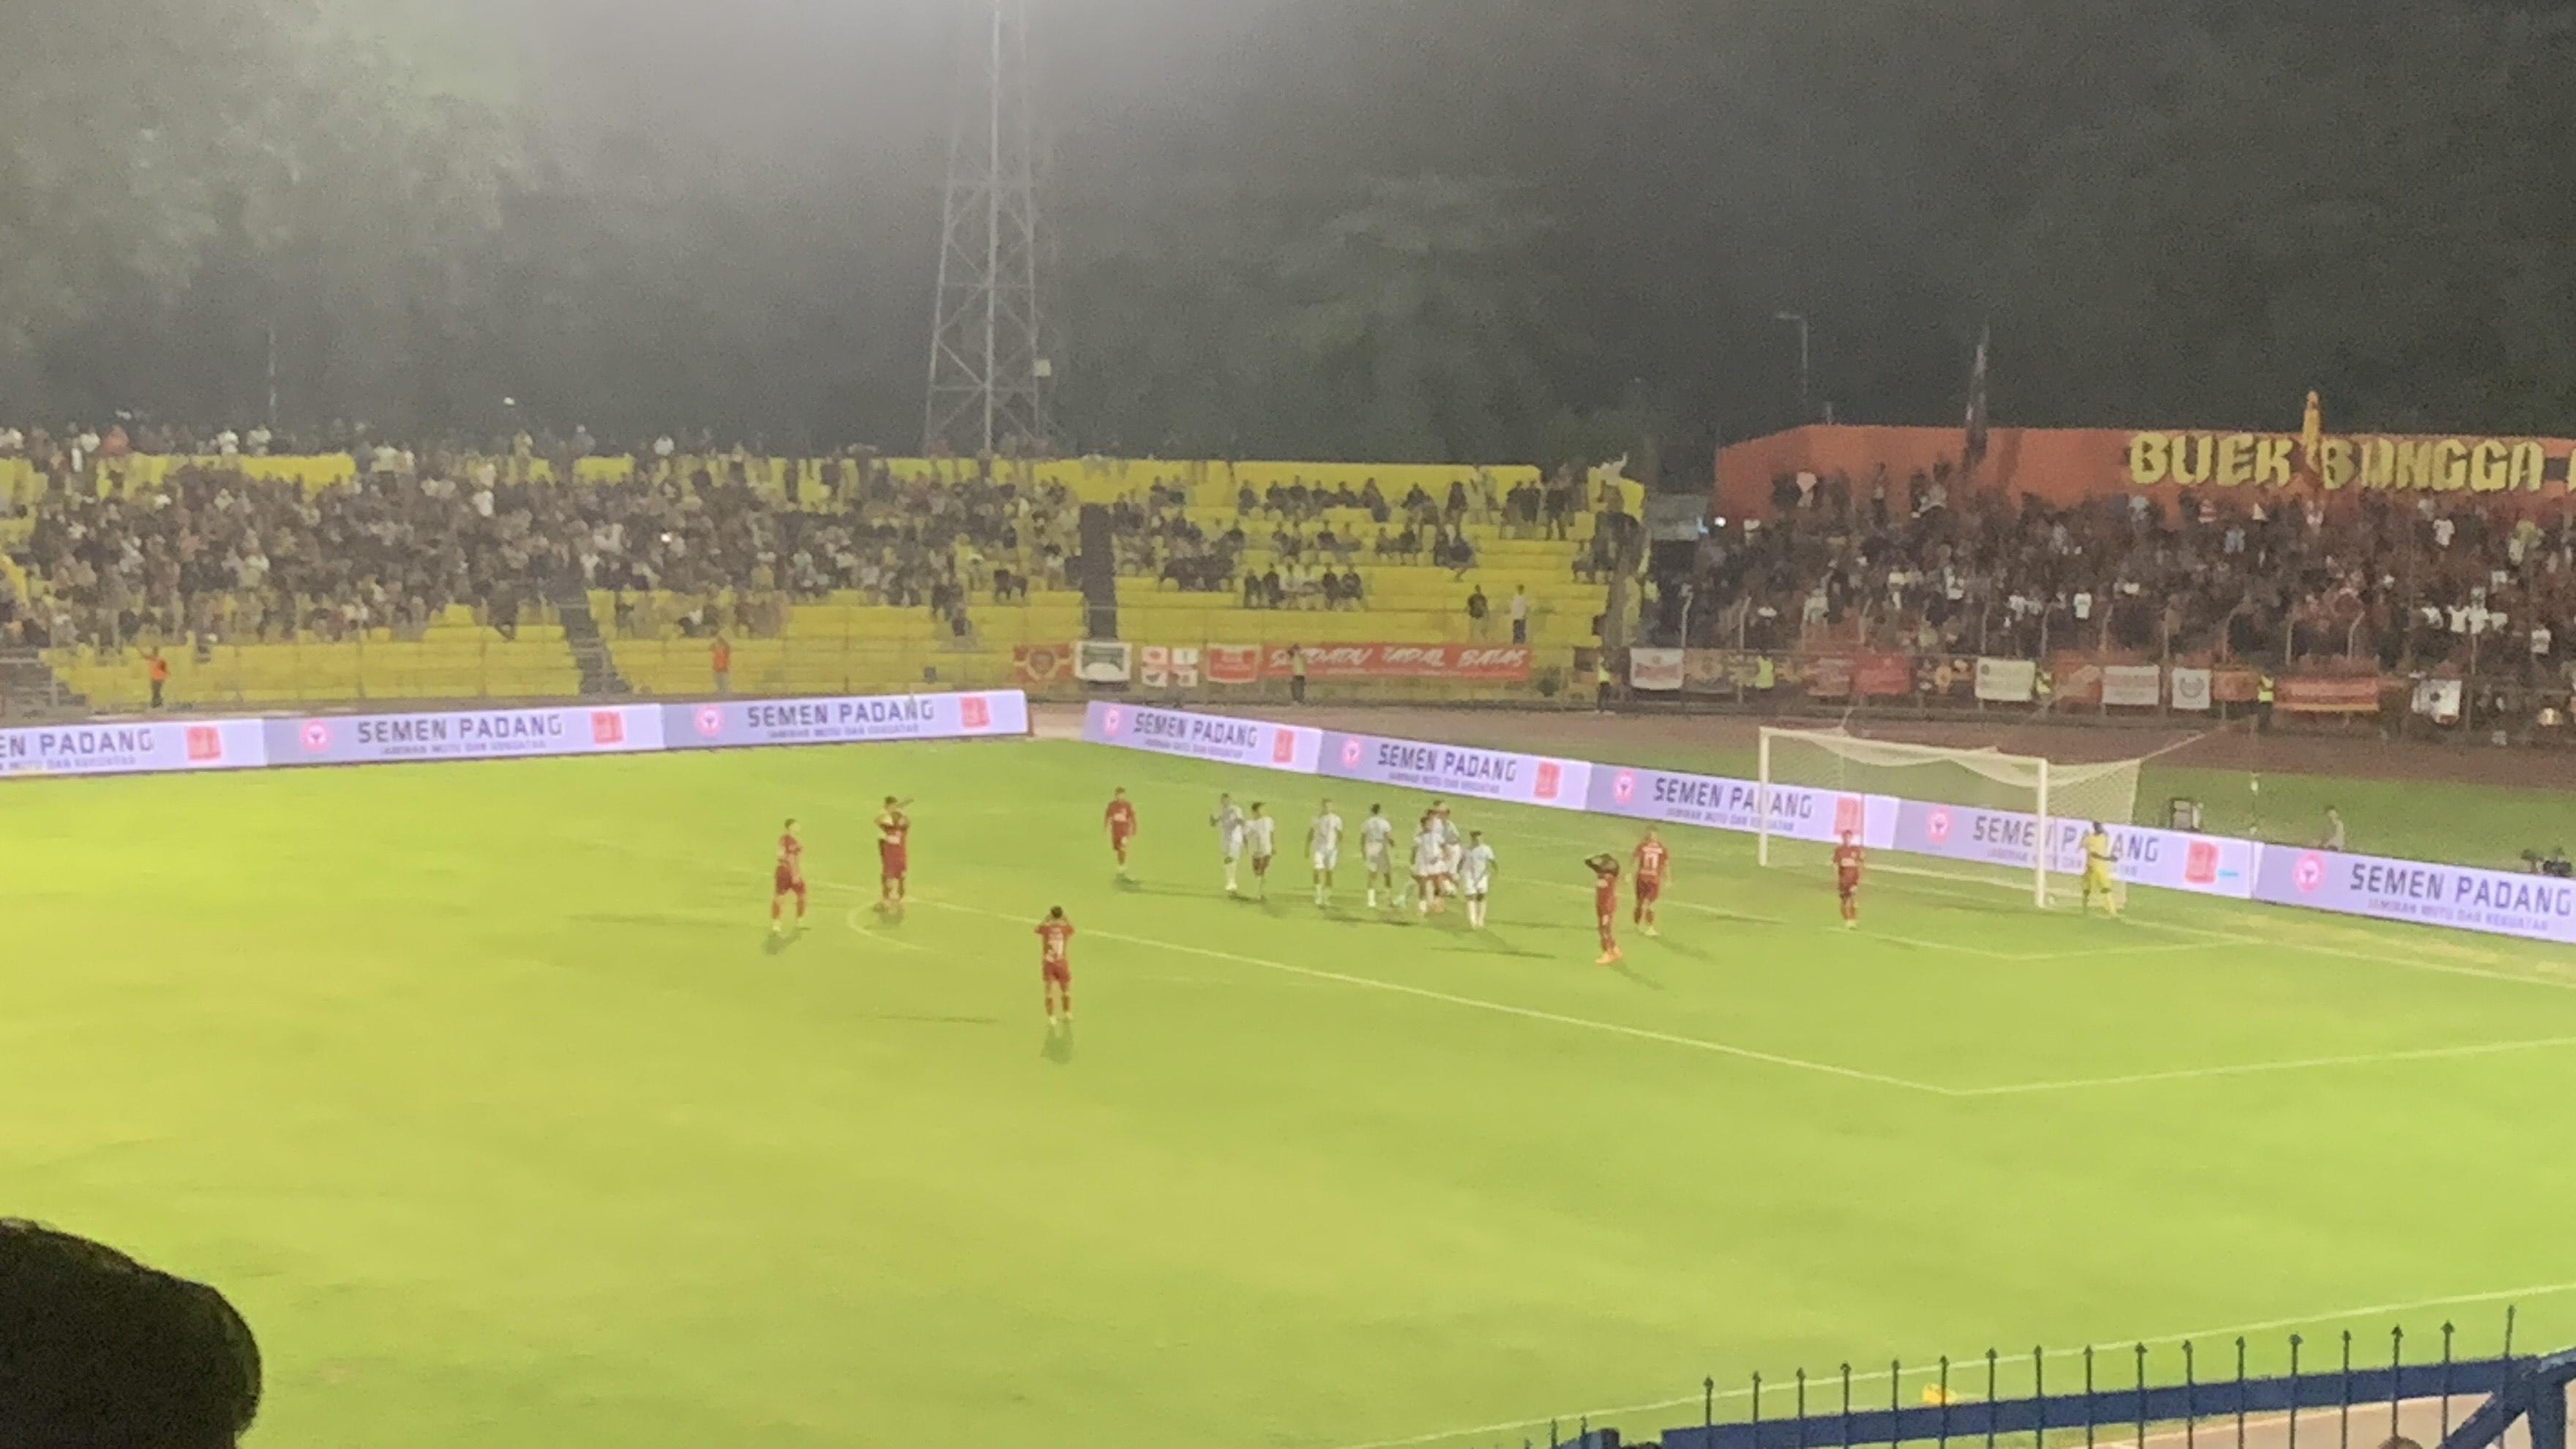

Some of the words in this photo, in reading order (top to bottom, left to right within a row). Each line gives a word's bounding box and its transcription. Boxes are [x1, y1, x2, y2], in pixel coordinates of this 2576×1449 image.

[358, 719, 447, 744] SEMEN
[460, 714, 563, 739] PADANG
[747, 703, 828, 727] SEMEN
[839, 699, 935, 723] PADANG
[1134, 712, 1187, 738] SEMEN
[1192, 719, 1259, 749] PADANG
[39, 728, 155, 756] PADANG
[1377, 744, 1437, 771] SEMEN
[1443, 752, 1517, 782] PADANG
[1652, 776, 1724, 807] SEMEN
[1729, 787, 1813, 819] PAANG
[2062, 825, 2160, 863] PANG
[2350, 863, 2445, 901] SEMEN
[2455, 875, 2571, 916] PADANG
